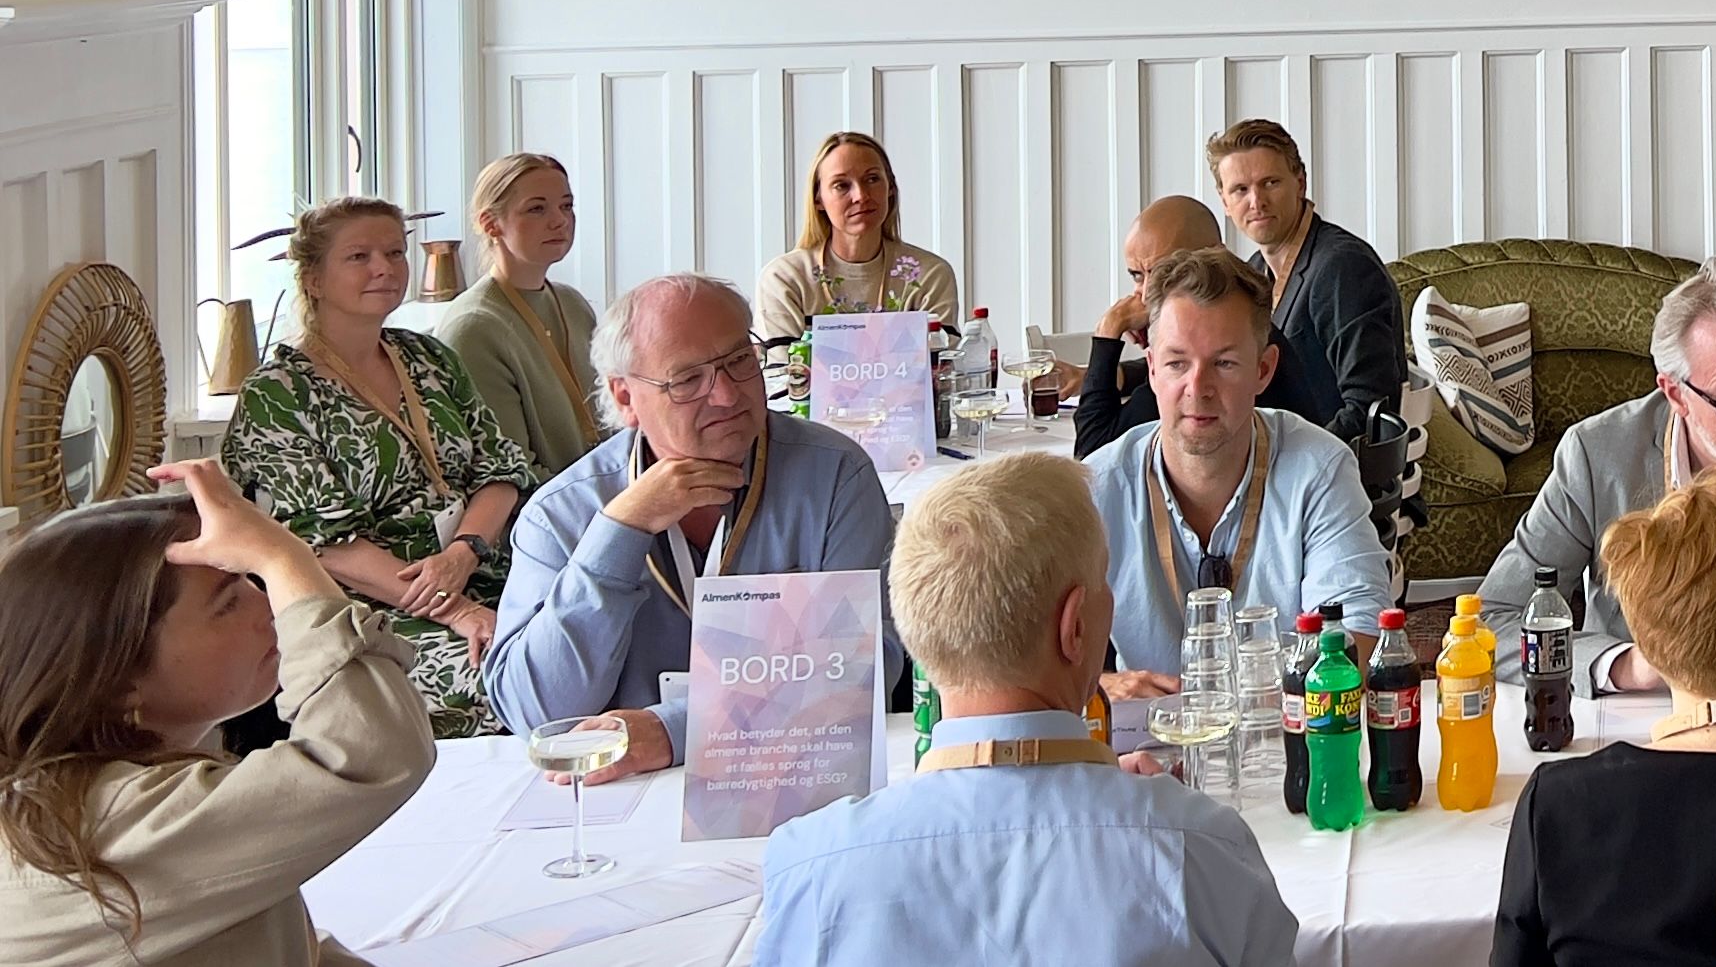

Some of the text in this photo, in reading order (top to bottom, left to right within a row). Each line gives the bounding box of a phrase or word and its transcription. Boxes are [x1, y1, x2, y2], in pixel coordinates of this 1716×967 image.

[828, 361, 908, 382] BORD 4
[719, 651, 846, 685] BORD 3
[707, 729, 737, 741] Hvad
[739, 728, 785, 742] betyder
[828, 724, 852, 735] den
[749, 743, 798, 756] branche
[800, 741, 824, 752] skal
[777, 760, 811, 773] sprog
[813, 757, 831, 768] for
[799, 776, 814, 788] og
[816, 772, 848, 785] ESG?
